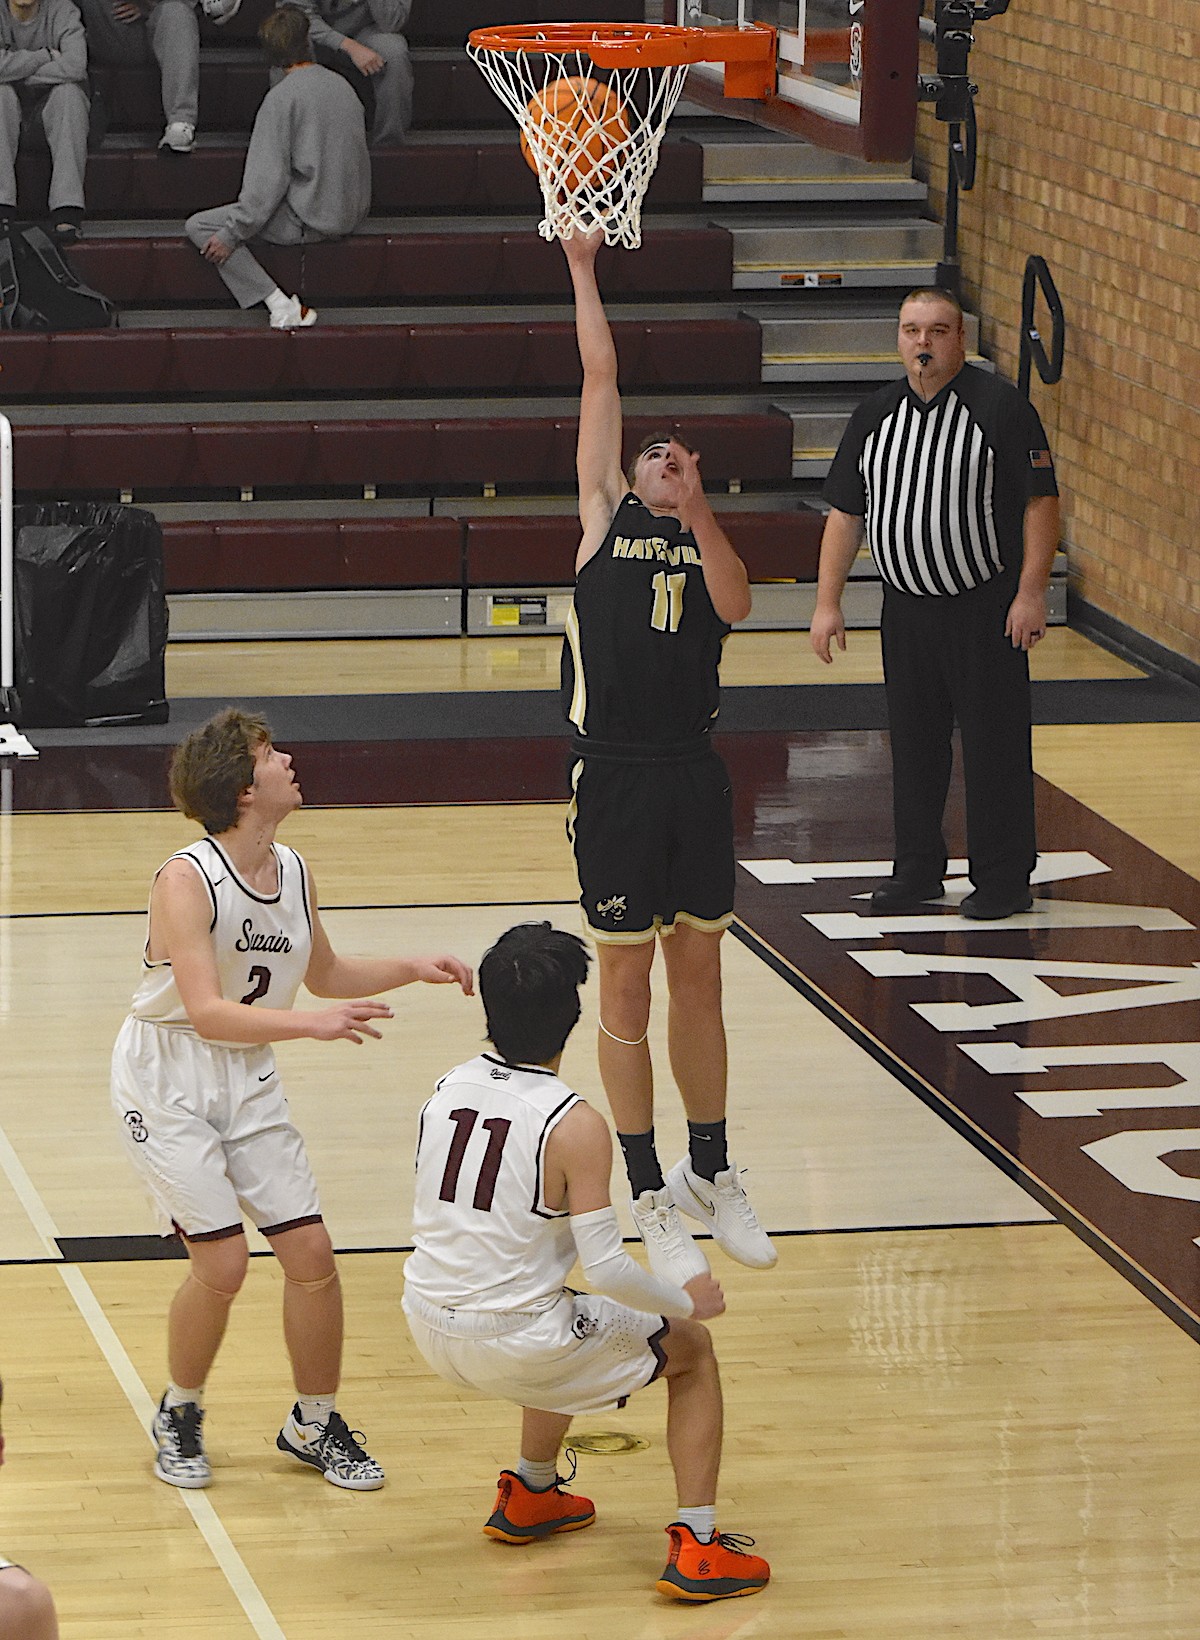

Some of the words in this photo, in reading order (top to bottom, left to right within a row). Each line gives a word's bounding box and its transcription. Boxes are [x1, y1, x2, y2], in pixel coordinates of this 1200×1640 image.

[650, 571, 687, 633] 11
[235, 918, 293, 953] Swain
[239, 965, 272, 1006] 2
[439, 1107, 512, 1213] 11
